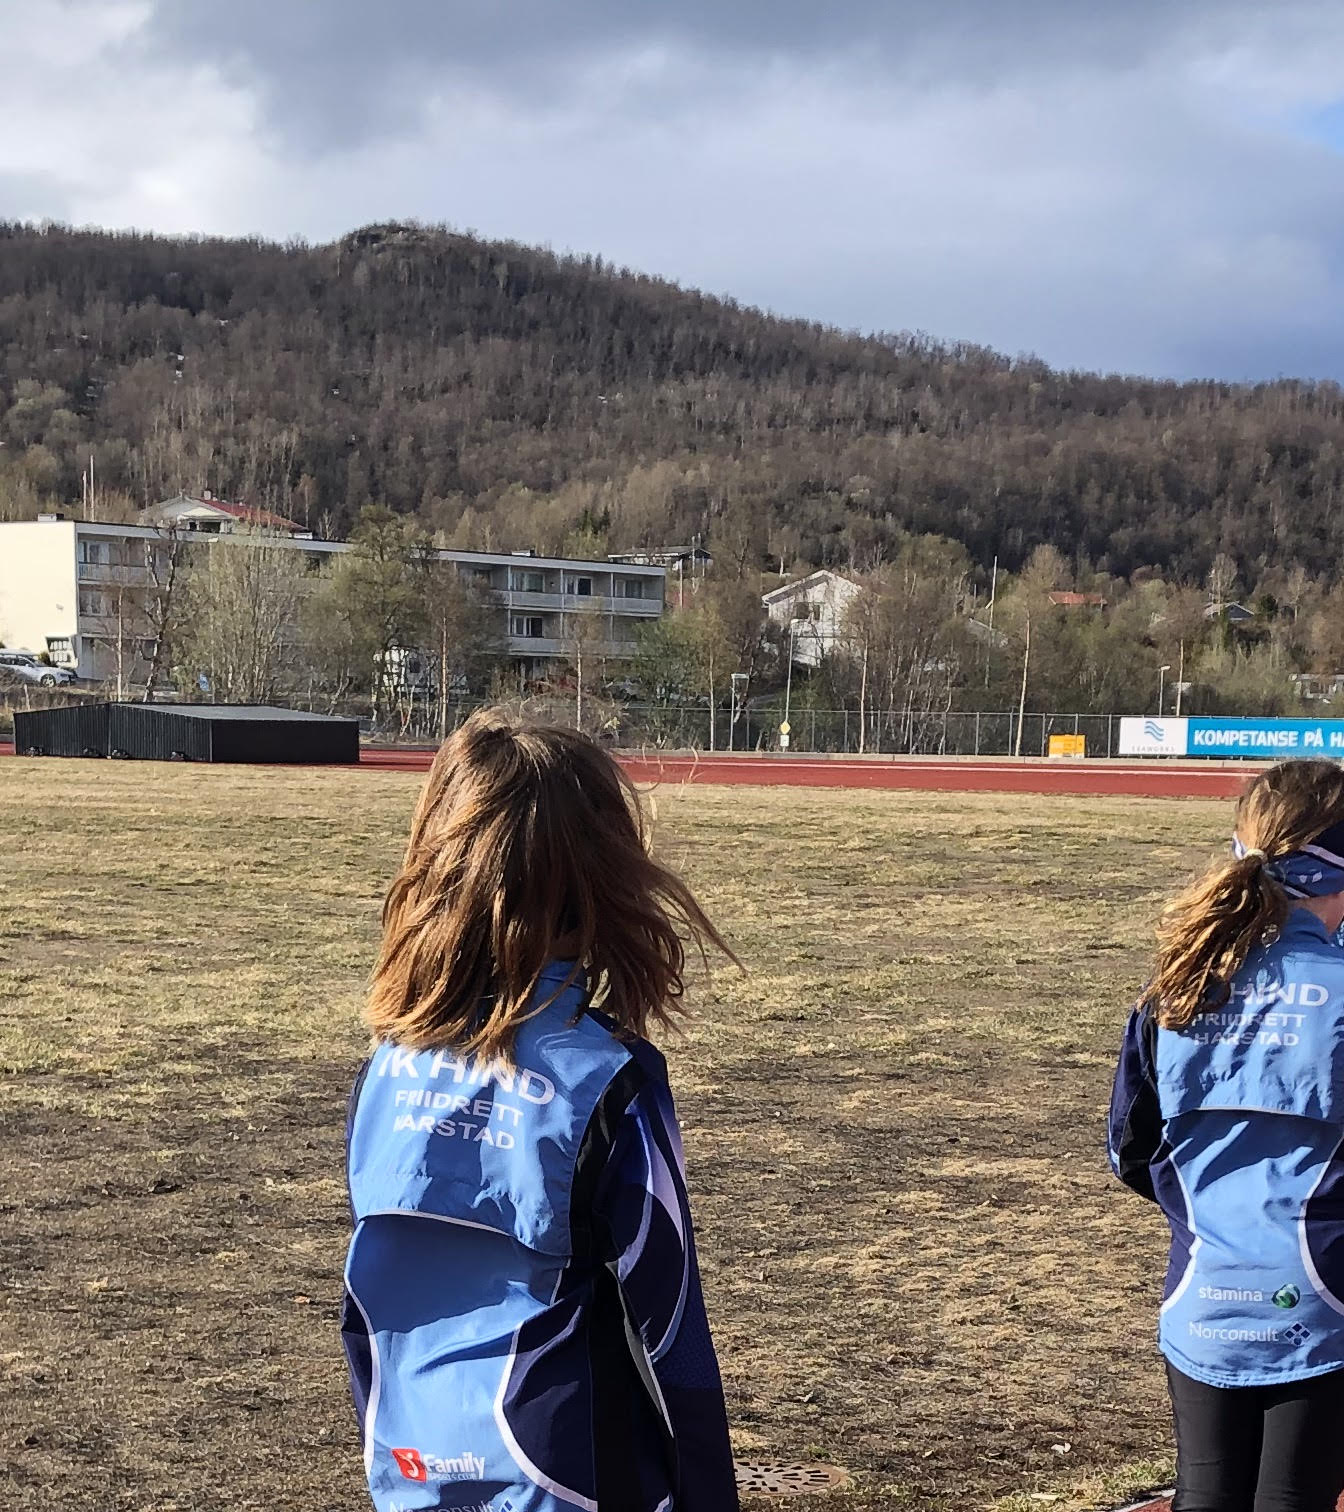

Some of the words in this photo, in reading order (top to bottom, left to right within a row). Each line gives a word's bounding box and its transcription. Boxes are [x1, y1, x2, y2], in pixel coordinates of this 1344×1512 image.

[1194, 729, 1298, 747] KOMPETANSE
[1304, 727, 1324, 748] PÅ
[429, 1049, 555, 1105] HIND
[1199, 1285, 1263, 1302] stamina
[1188, 1320, 1279, 1342] Norconsult
[423, 1452, 485, 1480] Family
